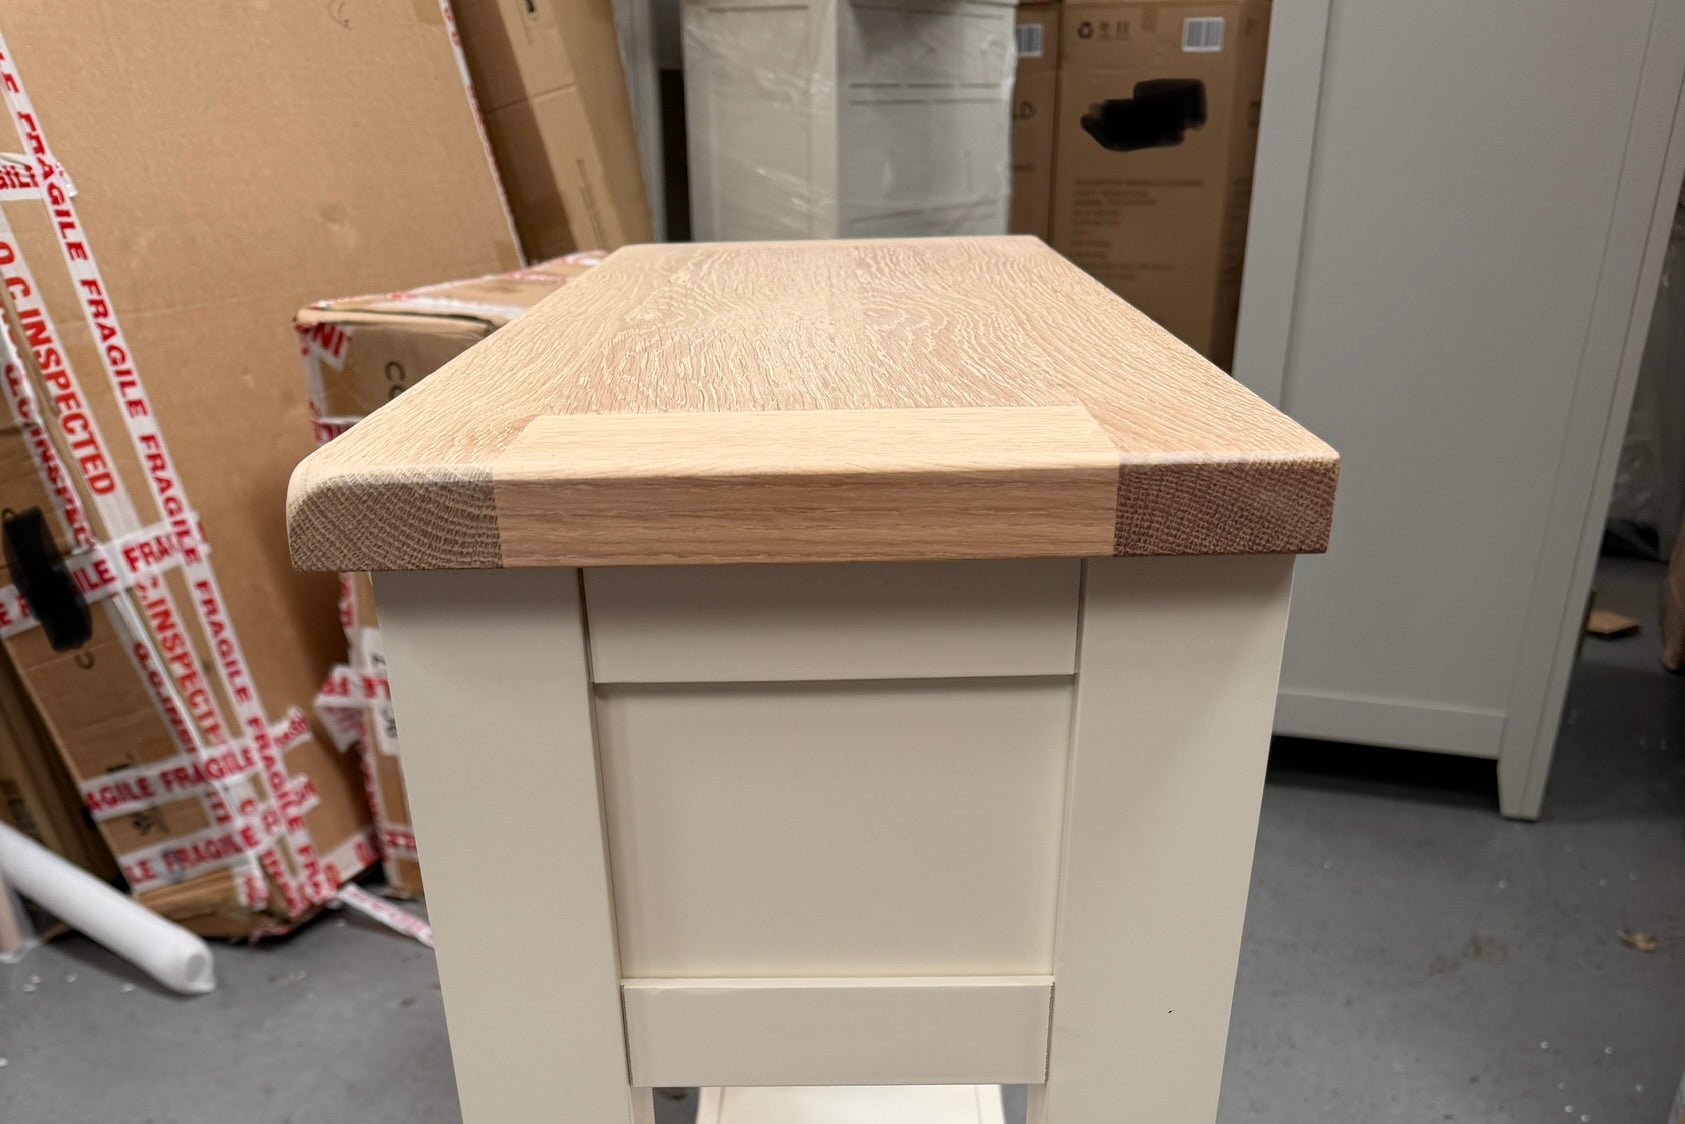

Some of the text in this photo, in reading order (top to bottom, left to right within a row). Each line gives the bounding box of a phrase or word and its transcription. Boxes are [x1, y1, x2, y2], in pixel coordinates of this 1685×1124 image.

[17, 308, 116, 496] INSPECTED
[80, 279, 148, 418] FRAGILE
[140, 434, 203, 567] FRAGILE
[195, 580, 252, 705] FRAGILE
[159, 747, 256, 791] FRAGILE
